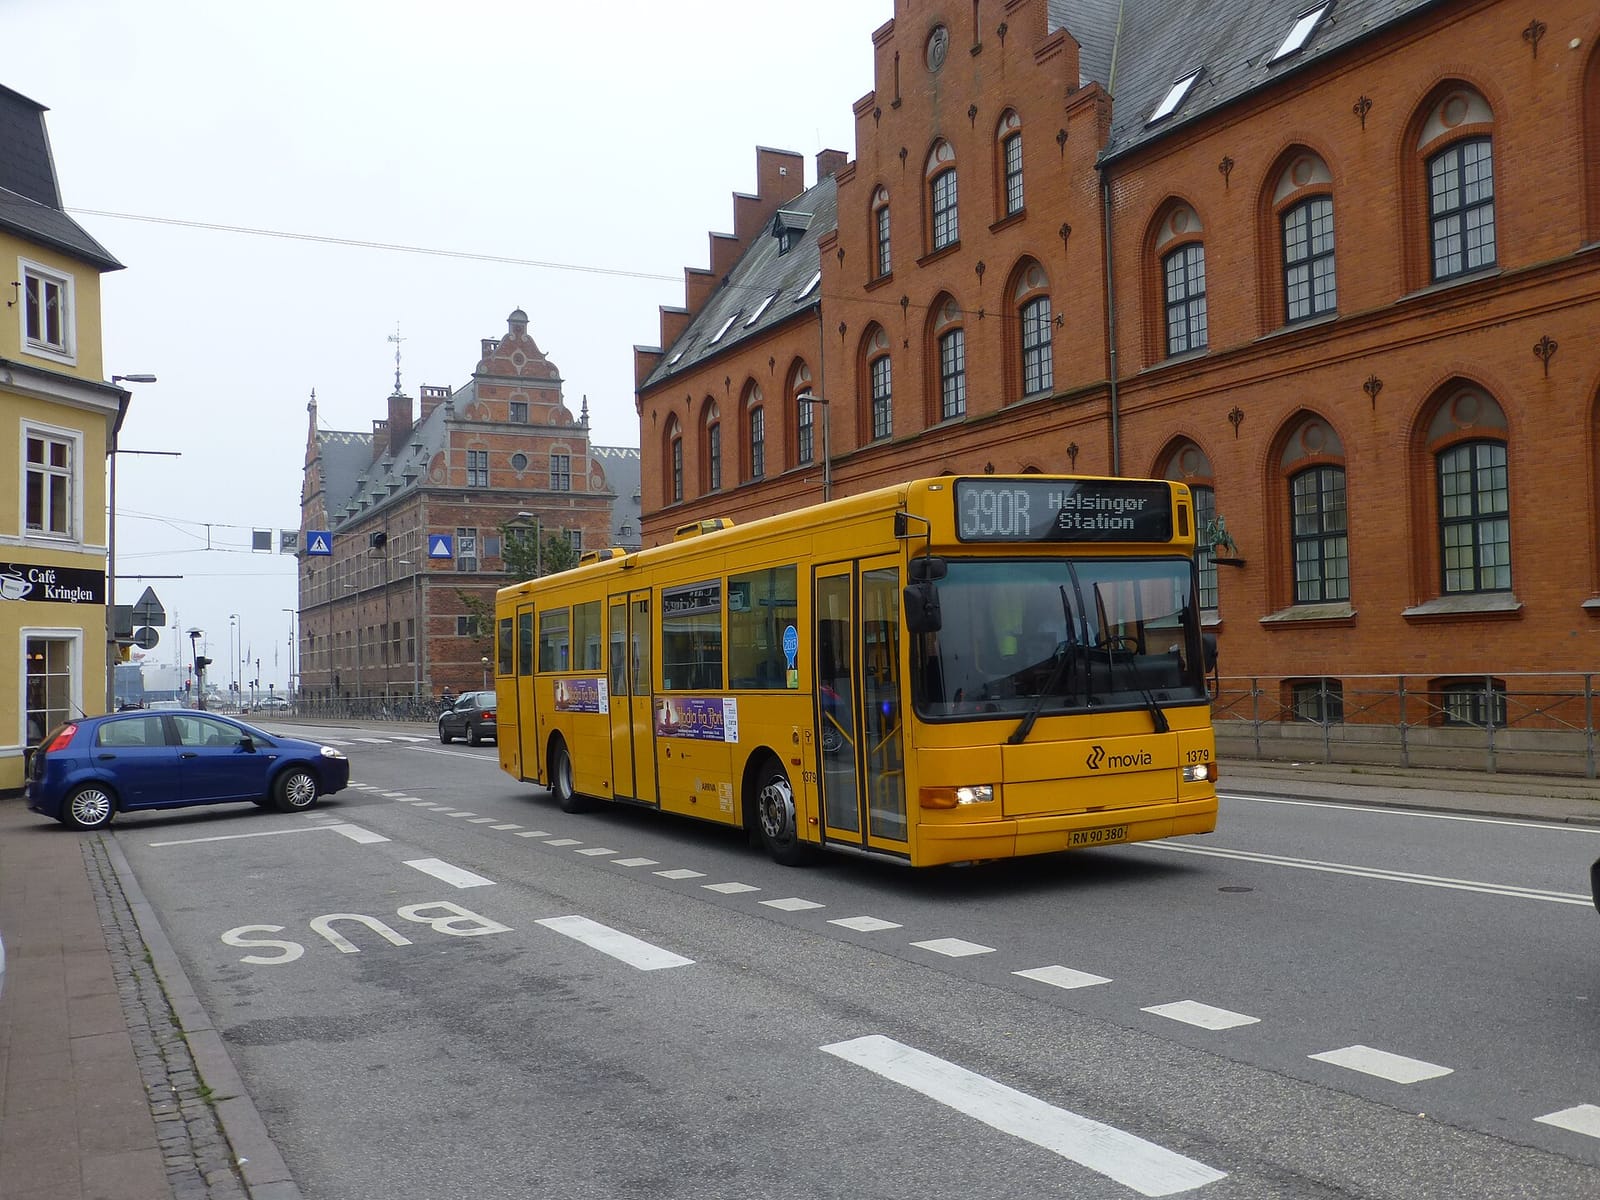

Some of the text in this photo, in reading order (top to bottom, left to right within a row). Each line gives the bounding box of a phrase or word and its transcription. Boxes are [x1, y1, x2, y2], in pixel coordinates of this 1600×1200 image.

[964, 489, 1030, 535] 390R
[1059, 512, 1134, 529] Station
[28, 568, 56, 584] Café
[44, 584, 93, 604] Kringlen
[1108, 749, 1152, 768] movia
[1186, 749, 1209, 763] 1379
[802, 771, 817, 783] 1379
[1073, 827, 1123, 844] RN 90 380
[221, 900, 515, 965] BUS
